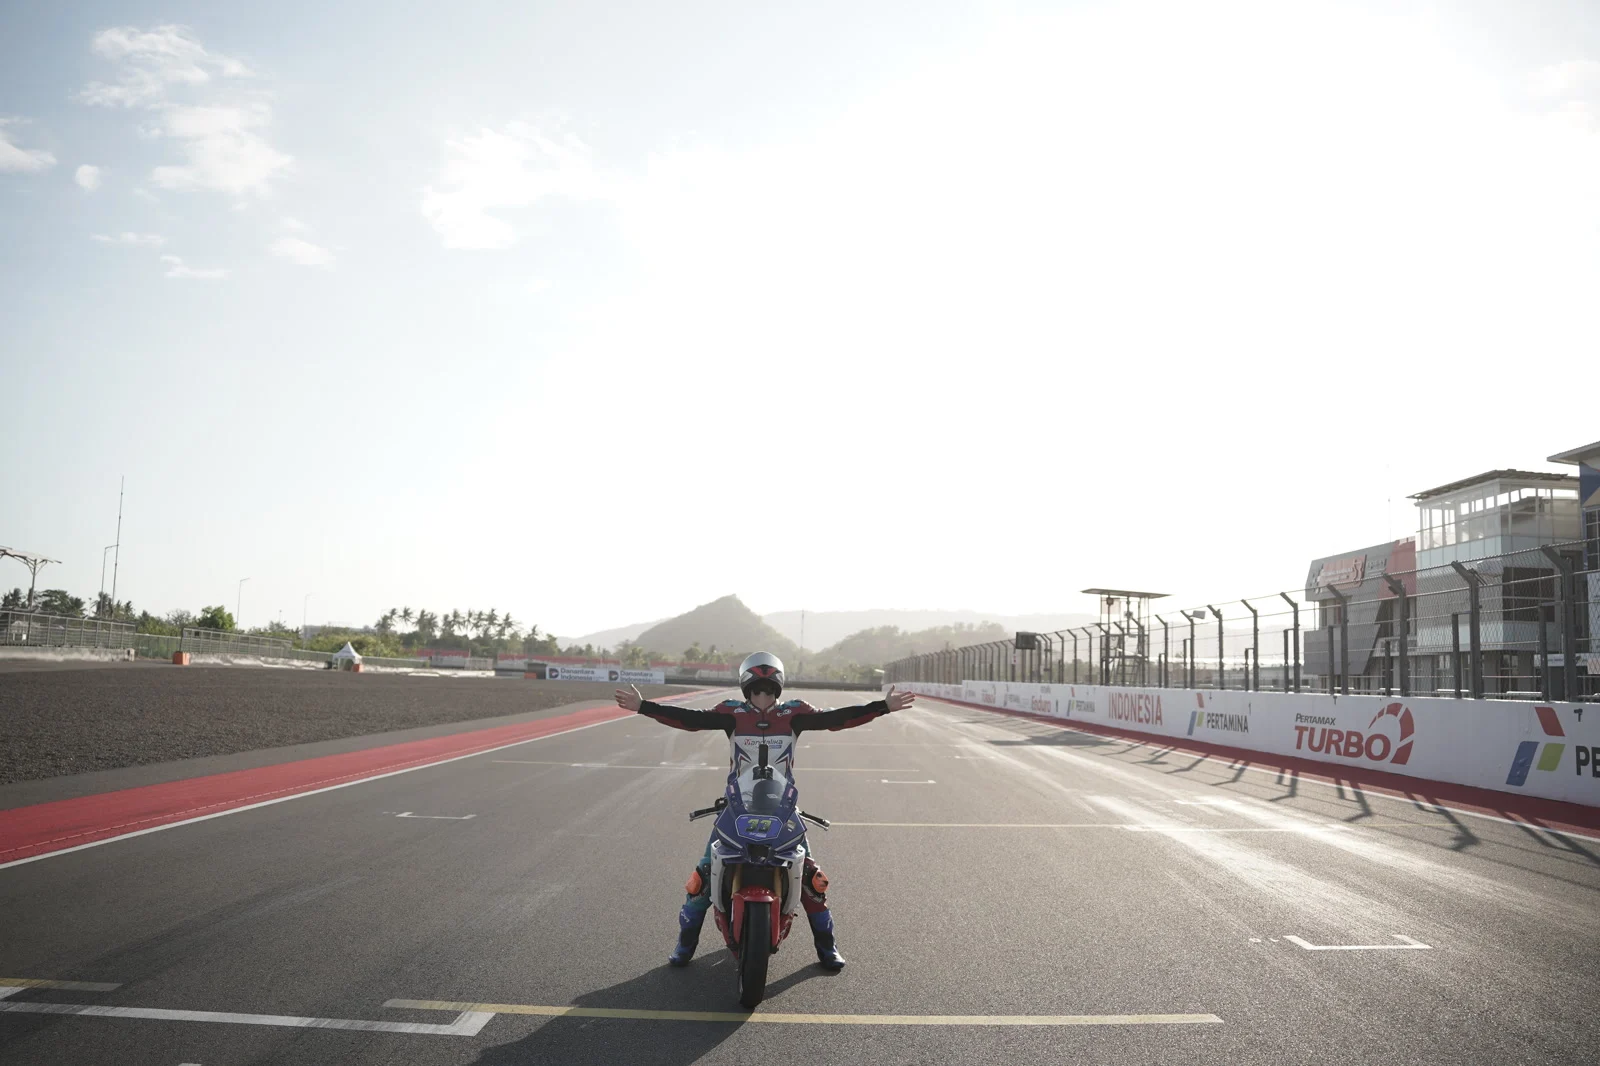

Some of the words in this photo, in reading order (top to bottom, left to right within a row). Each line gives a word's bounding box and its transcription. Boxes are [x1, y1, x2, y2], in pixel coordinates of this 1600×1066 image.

[560, 667, 595, 675] Danantara
[620, 670, 654, 678] Danantara
[1108, 692, 1163, 726] INDONESIA
[1206, 712, 1249, 733] PERTAMINA
[1295, 713, 1336, 725] PERTAMAX
[1294, 725, 1391, 761] TURBO
